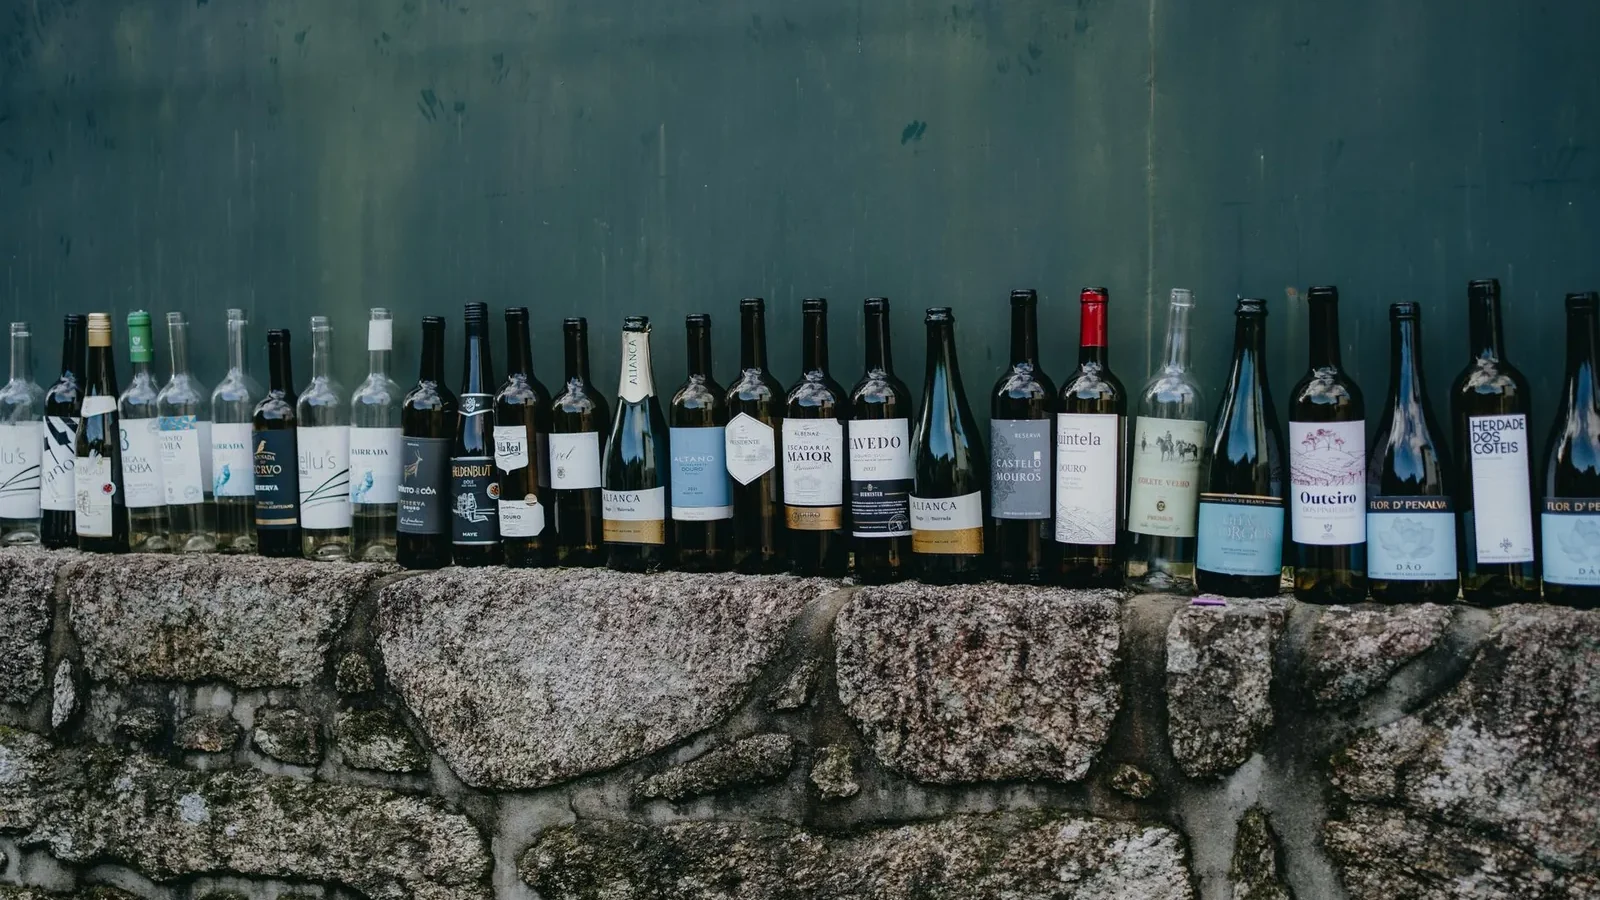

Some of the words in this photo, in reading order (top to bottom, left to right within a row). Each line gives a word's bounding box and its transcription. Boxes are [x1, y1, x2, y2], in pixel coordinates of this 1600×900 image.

[1472, 418, 1525, 432] HERDADE
[787, 451, 833, 464] MAIOR
[996, 459, 1042, 469] CASTELO
[452, 464, 492, 478] HELDENBLUT
[996, 472, 1041, 482] MOUROS
[1300, 491, 1357, 505] Outeiro
[1370, 501, 1390, 510] FLOR
[1405, 500, 1448, 510] PENALVA
[1547, 502, 1570, 511] FLOR
